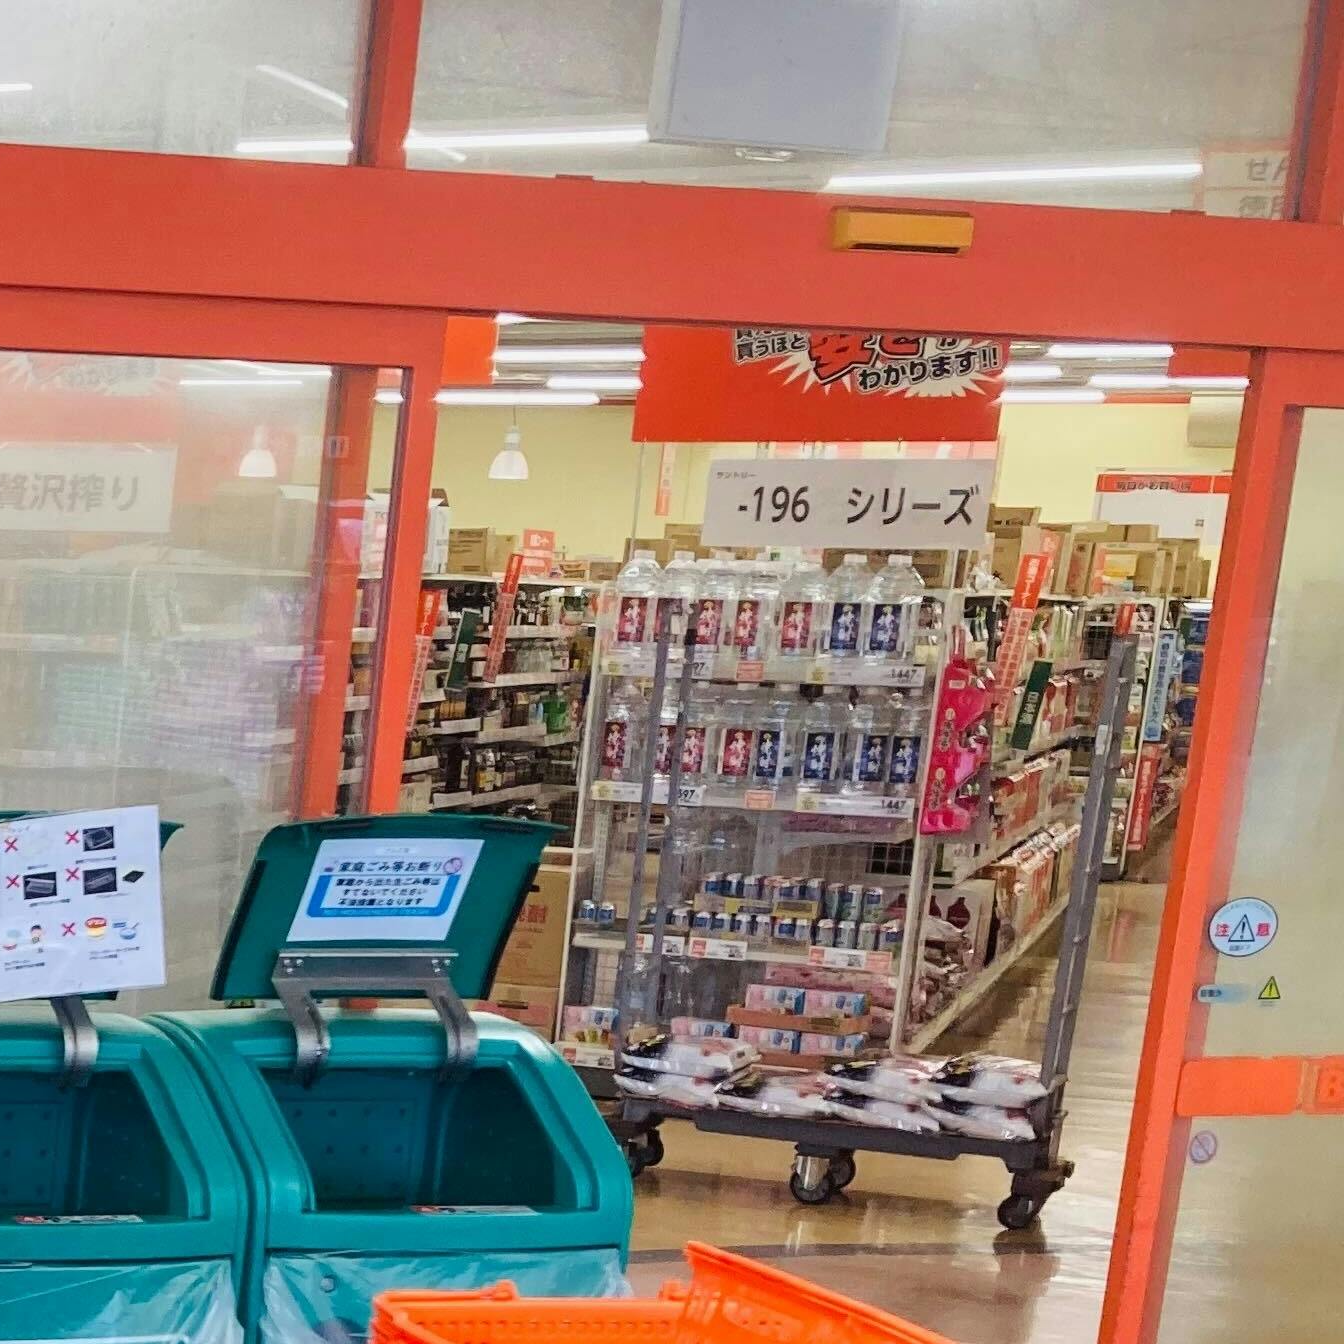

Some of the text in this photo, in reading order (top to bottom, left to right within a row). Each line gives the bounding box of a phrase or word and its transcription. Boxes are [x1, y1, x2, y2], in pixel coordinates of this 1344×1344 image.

[738, 484, 980, 526] -196 シリーズ
